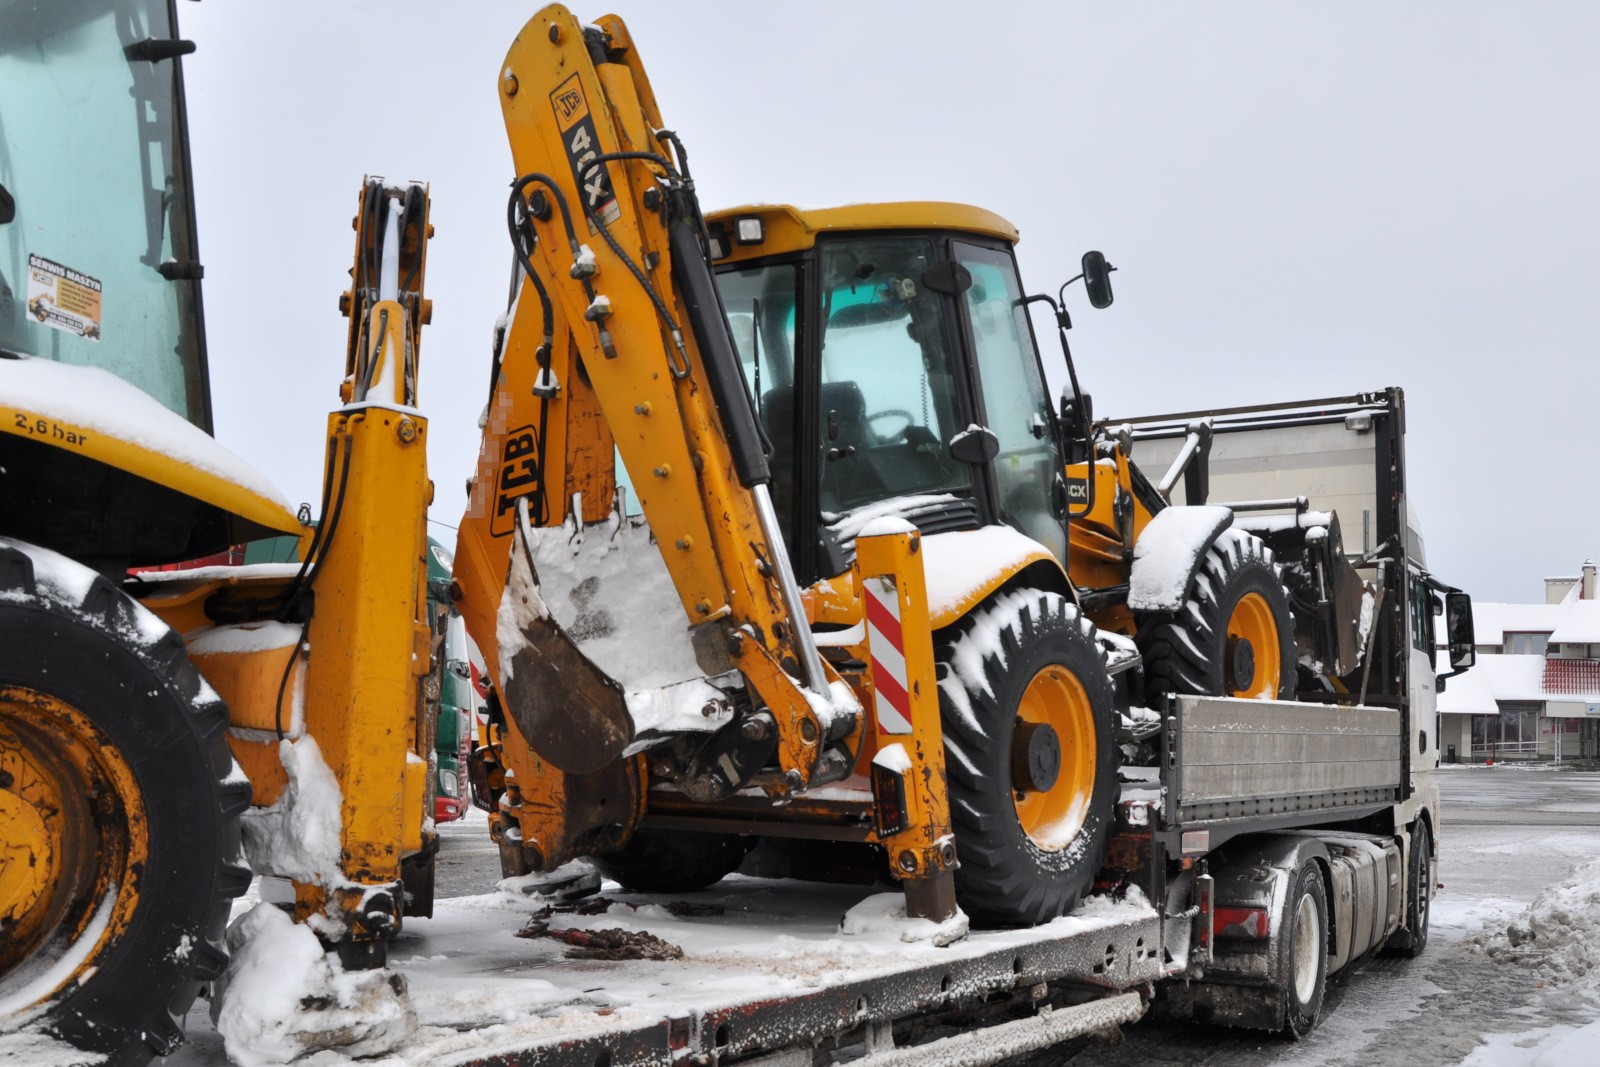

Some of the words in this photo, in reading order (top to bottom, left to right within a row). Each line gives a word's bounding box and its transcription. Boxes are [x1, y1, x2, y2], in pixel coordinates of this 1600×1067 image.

[560, 91, 580, 117] JCB
[30, 256, 65, 277] SERWIS
[66, 270, 100, 291] MASZYN
[15, 413, 47, 434] 2,6
[497, 433, 541, 527] JCB
[1068, 484, 1087, 497] CX
